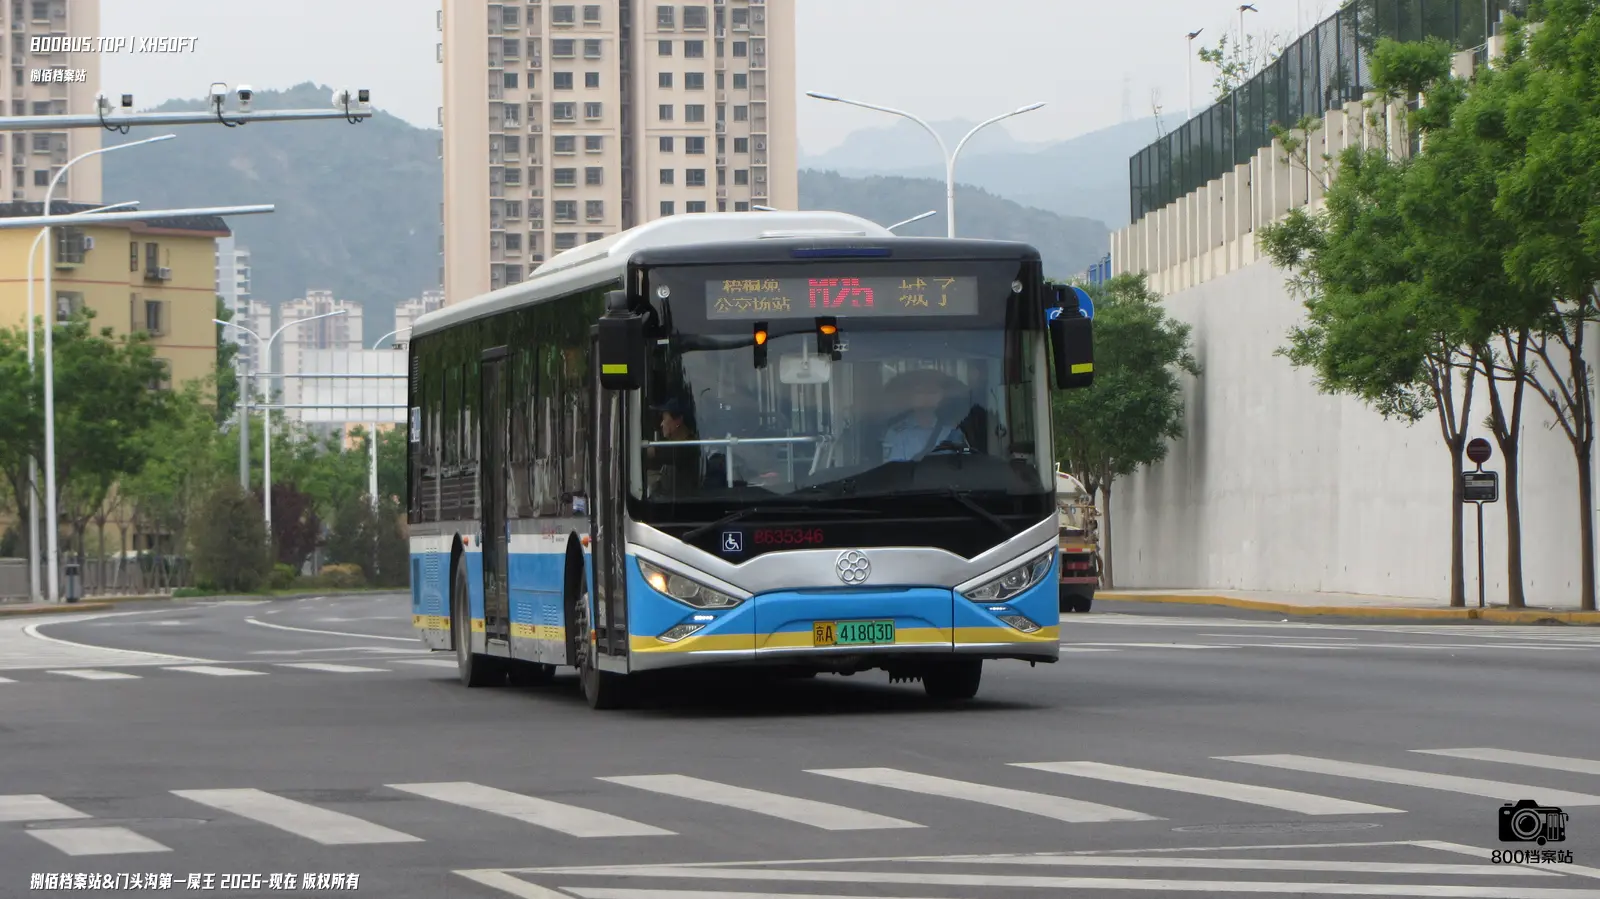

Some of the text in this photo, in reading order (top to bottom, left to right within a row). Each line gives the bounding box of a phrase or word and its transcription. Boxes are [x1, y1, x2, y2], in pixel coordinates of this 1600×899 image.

[808, 278, 875, 308] M25
[714, 297, 791, 313] 公交场站
